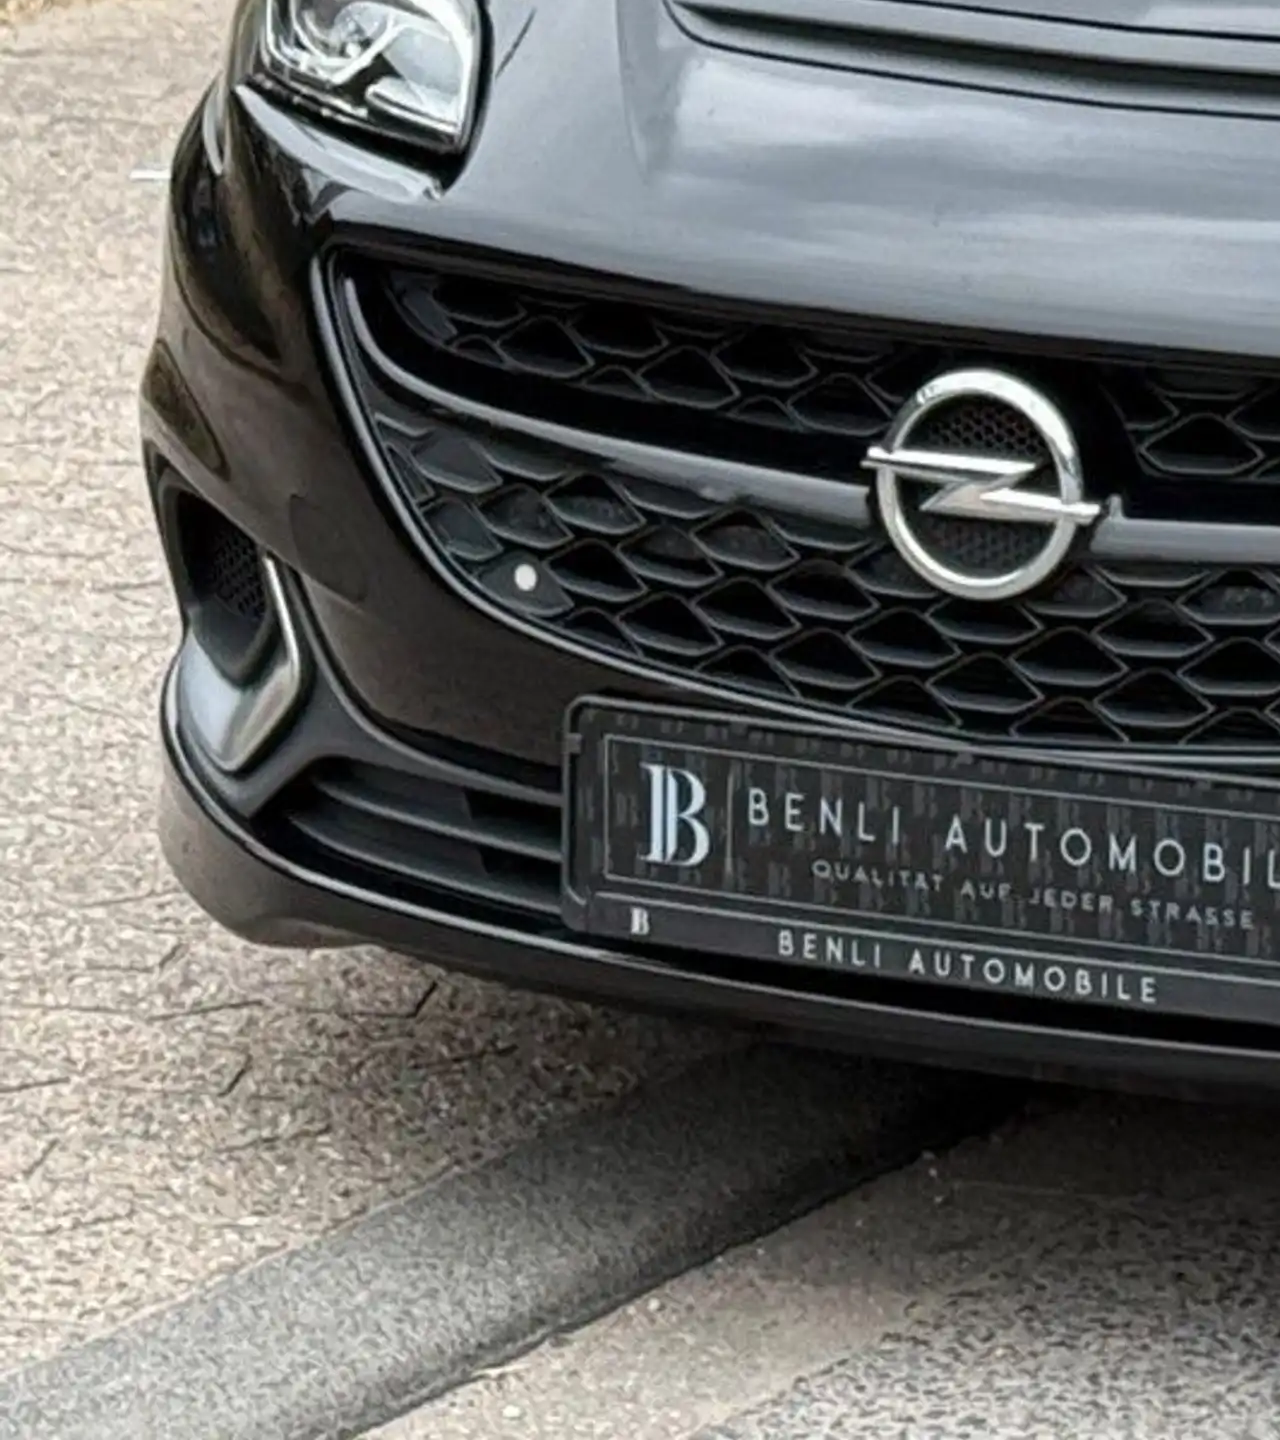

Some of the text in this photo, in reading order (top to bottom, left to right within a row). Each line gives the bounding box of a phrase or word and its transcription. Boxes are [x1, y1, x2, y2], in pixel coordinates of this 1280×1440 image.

[748, 787, 900, 845] BENLI
[960, 879, 1012, 900] AUF
[1029, 887, 1113, 913] JEDER
[1131, 899, 1254, 929] STRASSE
[778, 930, 1157, 1003] BENLI AUTOMOBILE
